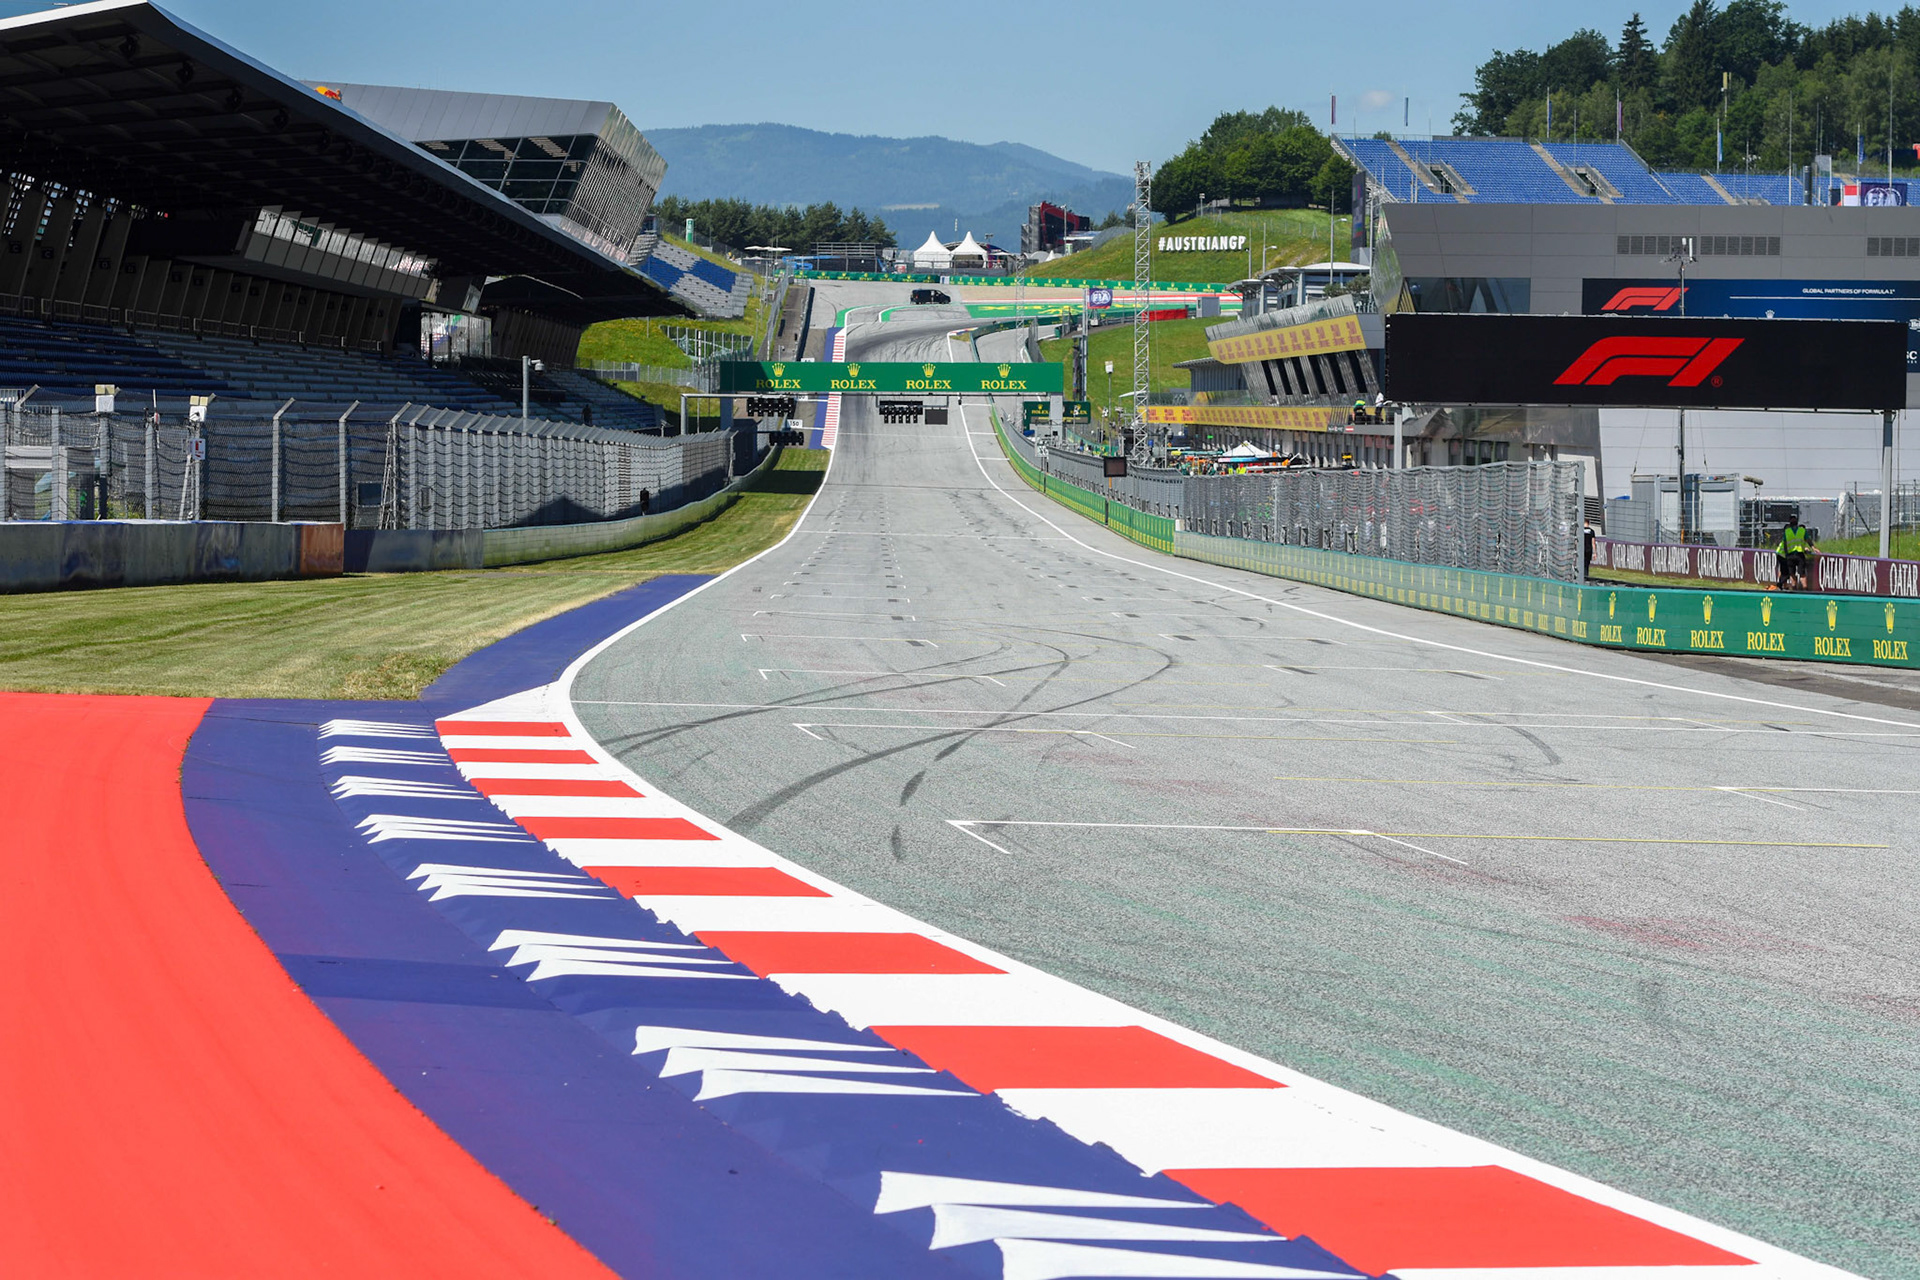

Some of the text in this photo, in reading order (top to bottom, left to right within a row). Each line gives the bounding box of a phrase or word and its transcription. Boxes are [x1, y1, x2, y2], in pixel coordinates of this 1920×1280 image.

[1158, 235, 1247, 251] #AUSTRIANGP
[1552, 335, 1746, 387] F1
[756, 379, 801, 389] ROLEX
[830, 379, 877, 390] ROLEX
[905, 380, 952, 390] ROLEX
[981, 380, 1027, 390] ROLEX
[1651, 546, 1690, 575] QATAR AIRWAYS
[1697, 548, 1718, 579] QATAR
[1718, 550, 1744, 579] AIRWAYS
[1753, 551, 1777, 584] QATAR
[1818, 556, 1844, 592] QATAR
[1844, 558, 1877, 594] AIRWAYS
[1600, 625, 1622, 643] ROLEX
[1636, 627, 1666, 647] ROLEX
[1690, 630, 1724, 649] ROLEX
[1747, 632, 1785, 652] ROLEX
[1814, 636, 1851, 657] ROLEX
[1872, 639, 1908, 661] ROLEX
